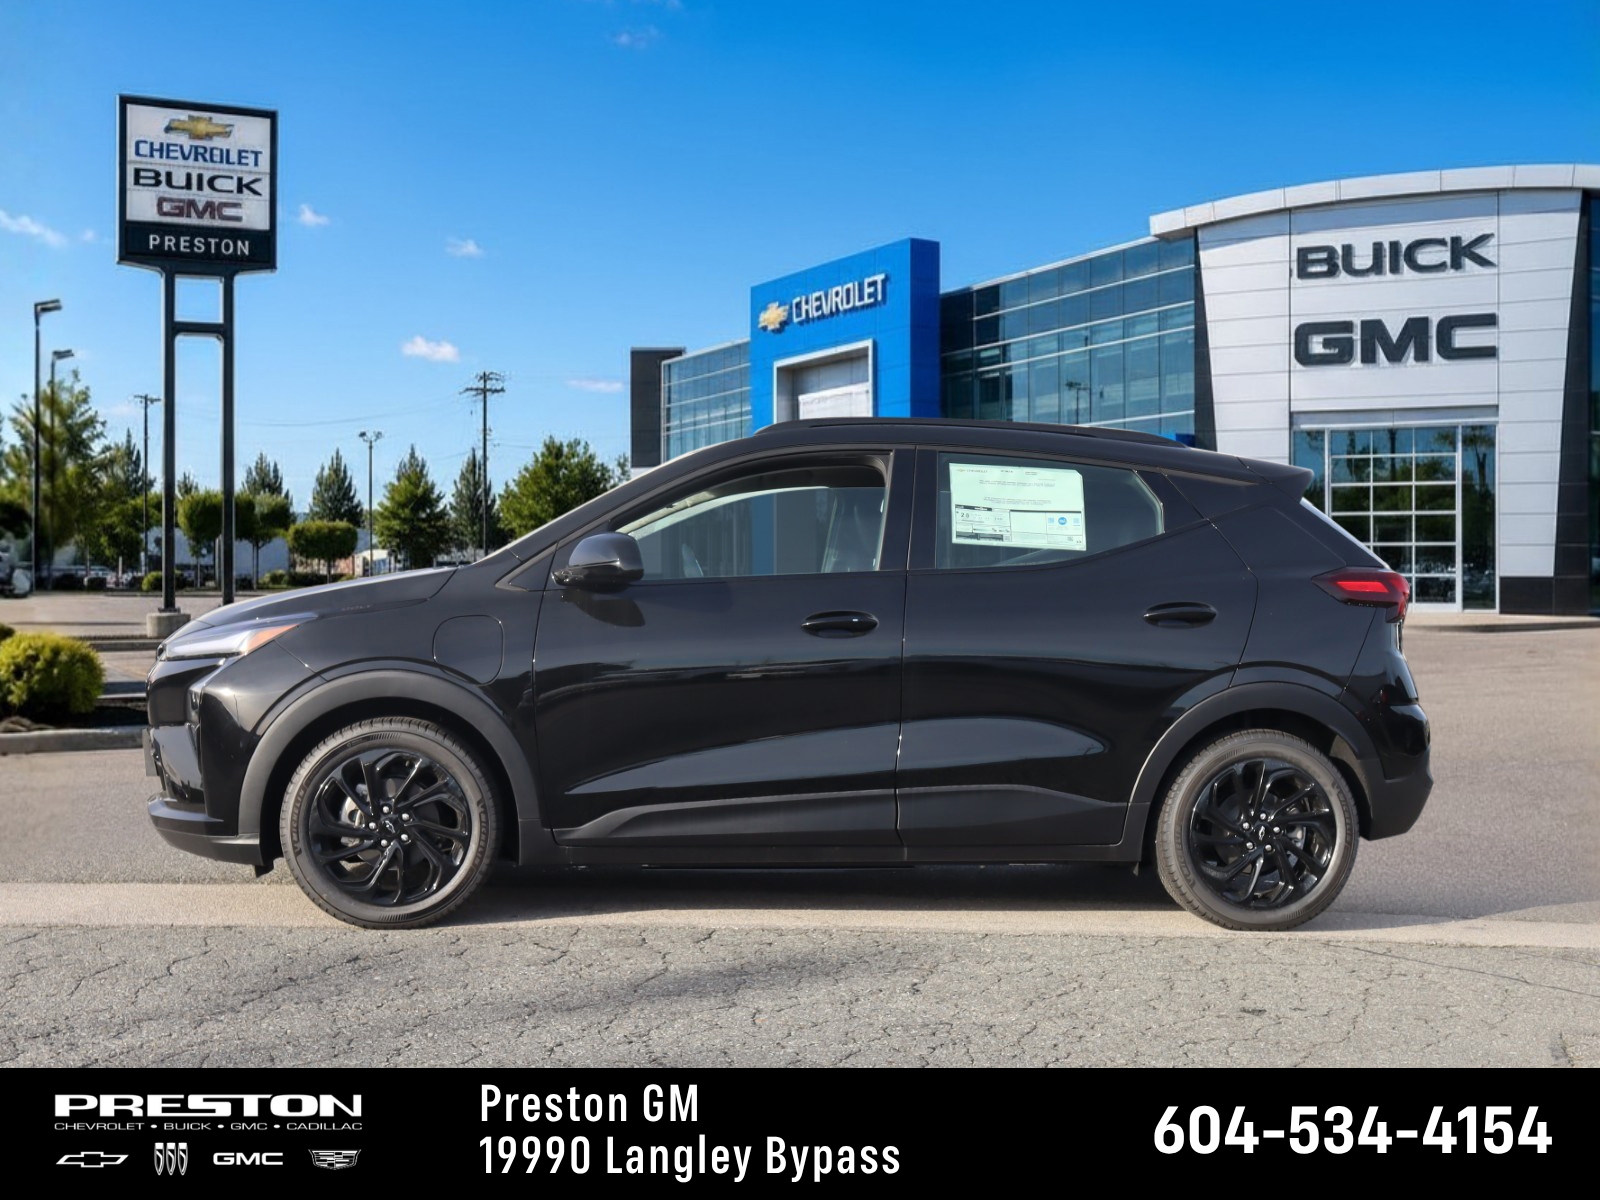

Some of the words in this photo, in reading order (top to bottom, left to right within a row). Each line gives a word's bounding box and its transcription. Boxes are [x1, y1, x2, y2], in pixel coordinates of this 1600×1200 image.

[134, 140, 263, 167] CHEVROLET
[133, 167, 262, 197] BUICK
[156, 196, 243, 223] GMC
[149, 234, 250, 256] PRESTON
[1297, 233, 1497, 279] BUICK
[792, 273, 886, 324] CHEVROLET
[1295, 313, 1498, 367] GMC
